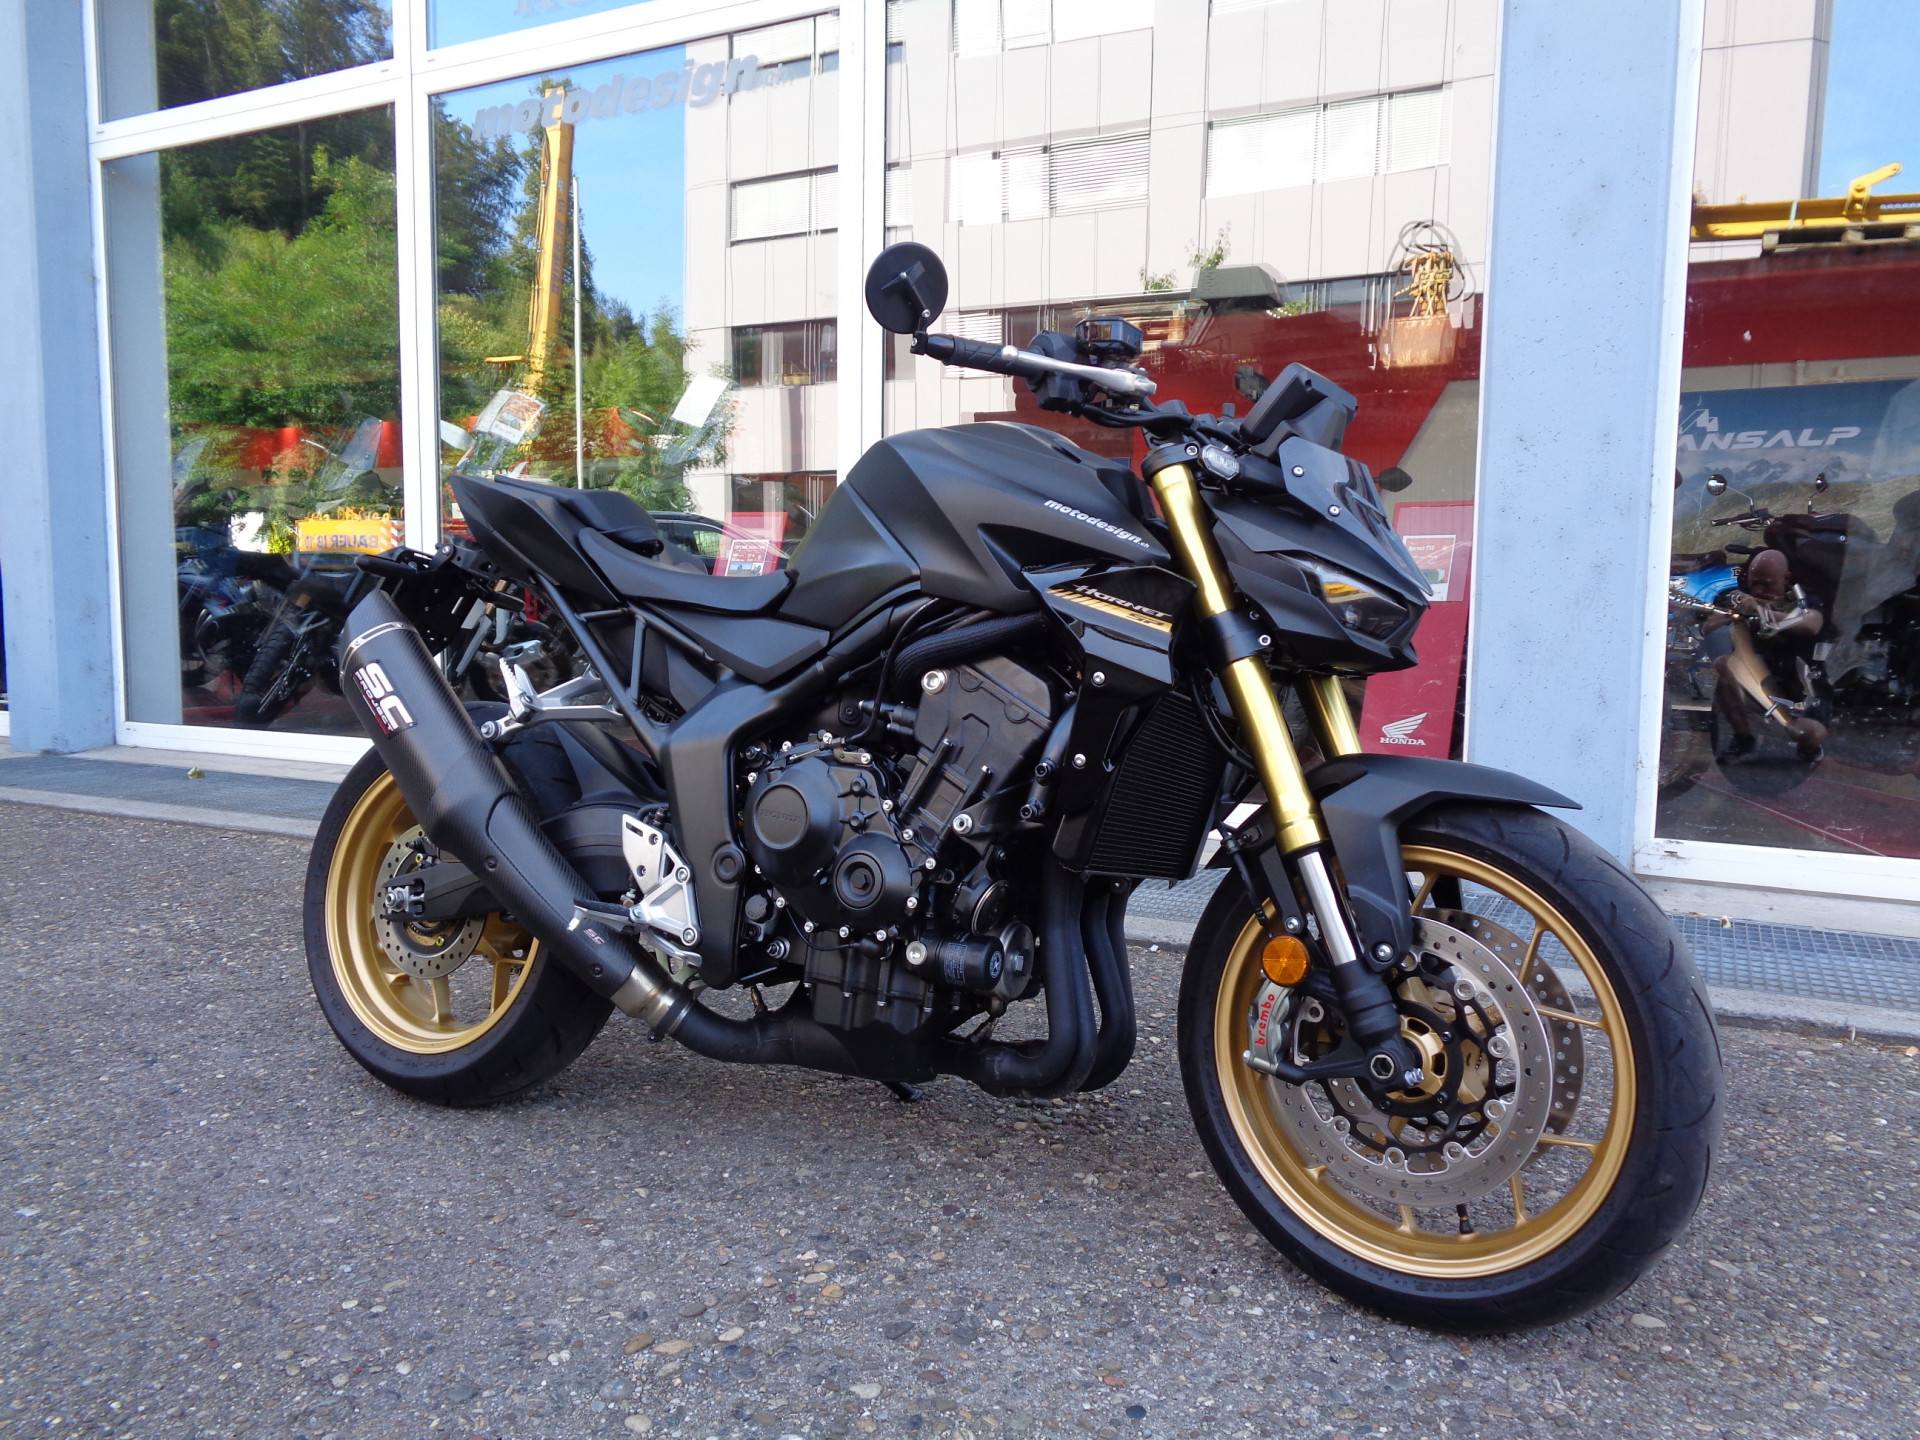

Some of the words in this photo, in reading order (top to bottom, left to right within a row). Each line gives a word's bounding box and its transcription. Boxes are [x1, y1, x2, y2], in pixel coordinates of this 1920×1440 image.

[1044, 499, 1150, 549] motodesign.ch
[1072, 584, 1173, 618] HORNET
[1126, 612, 1165, 626] SP
[354, 670, 395, 732] PROJECT
[359, 662, 414, 731] SC
[1380, 736, 1427, 746] HONDA
[1254, 993, 1276, 1047] brembo
